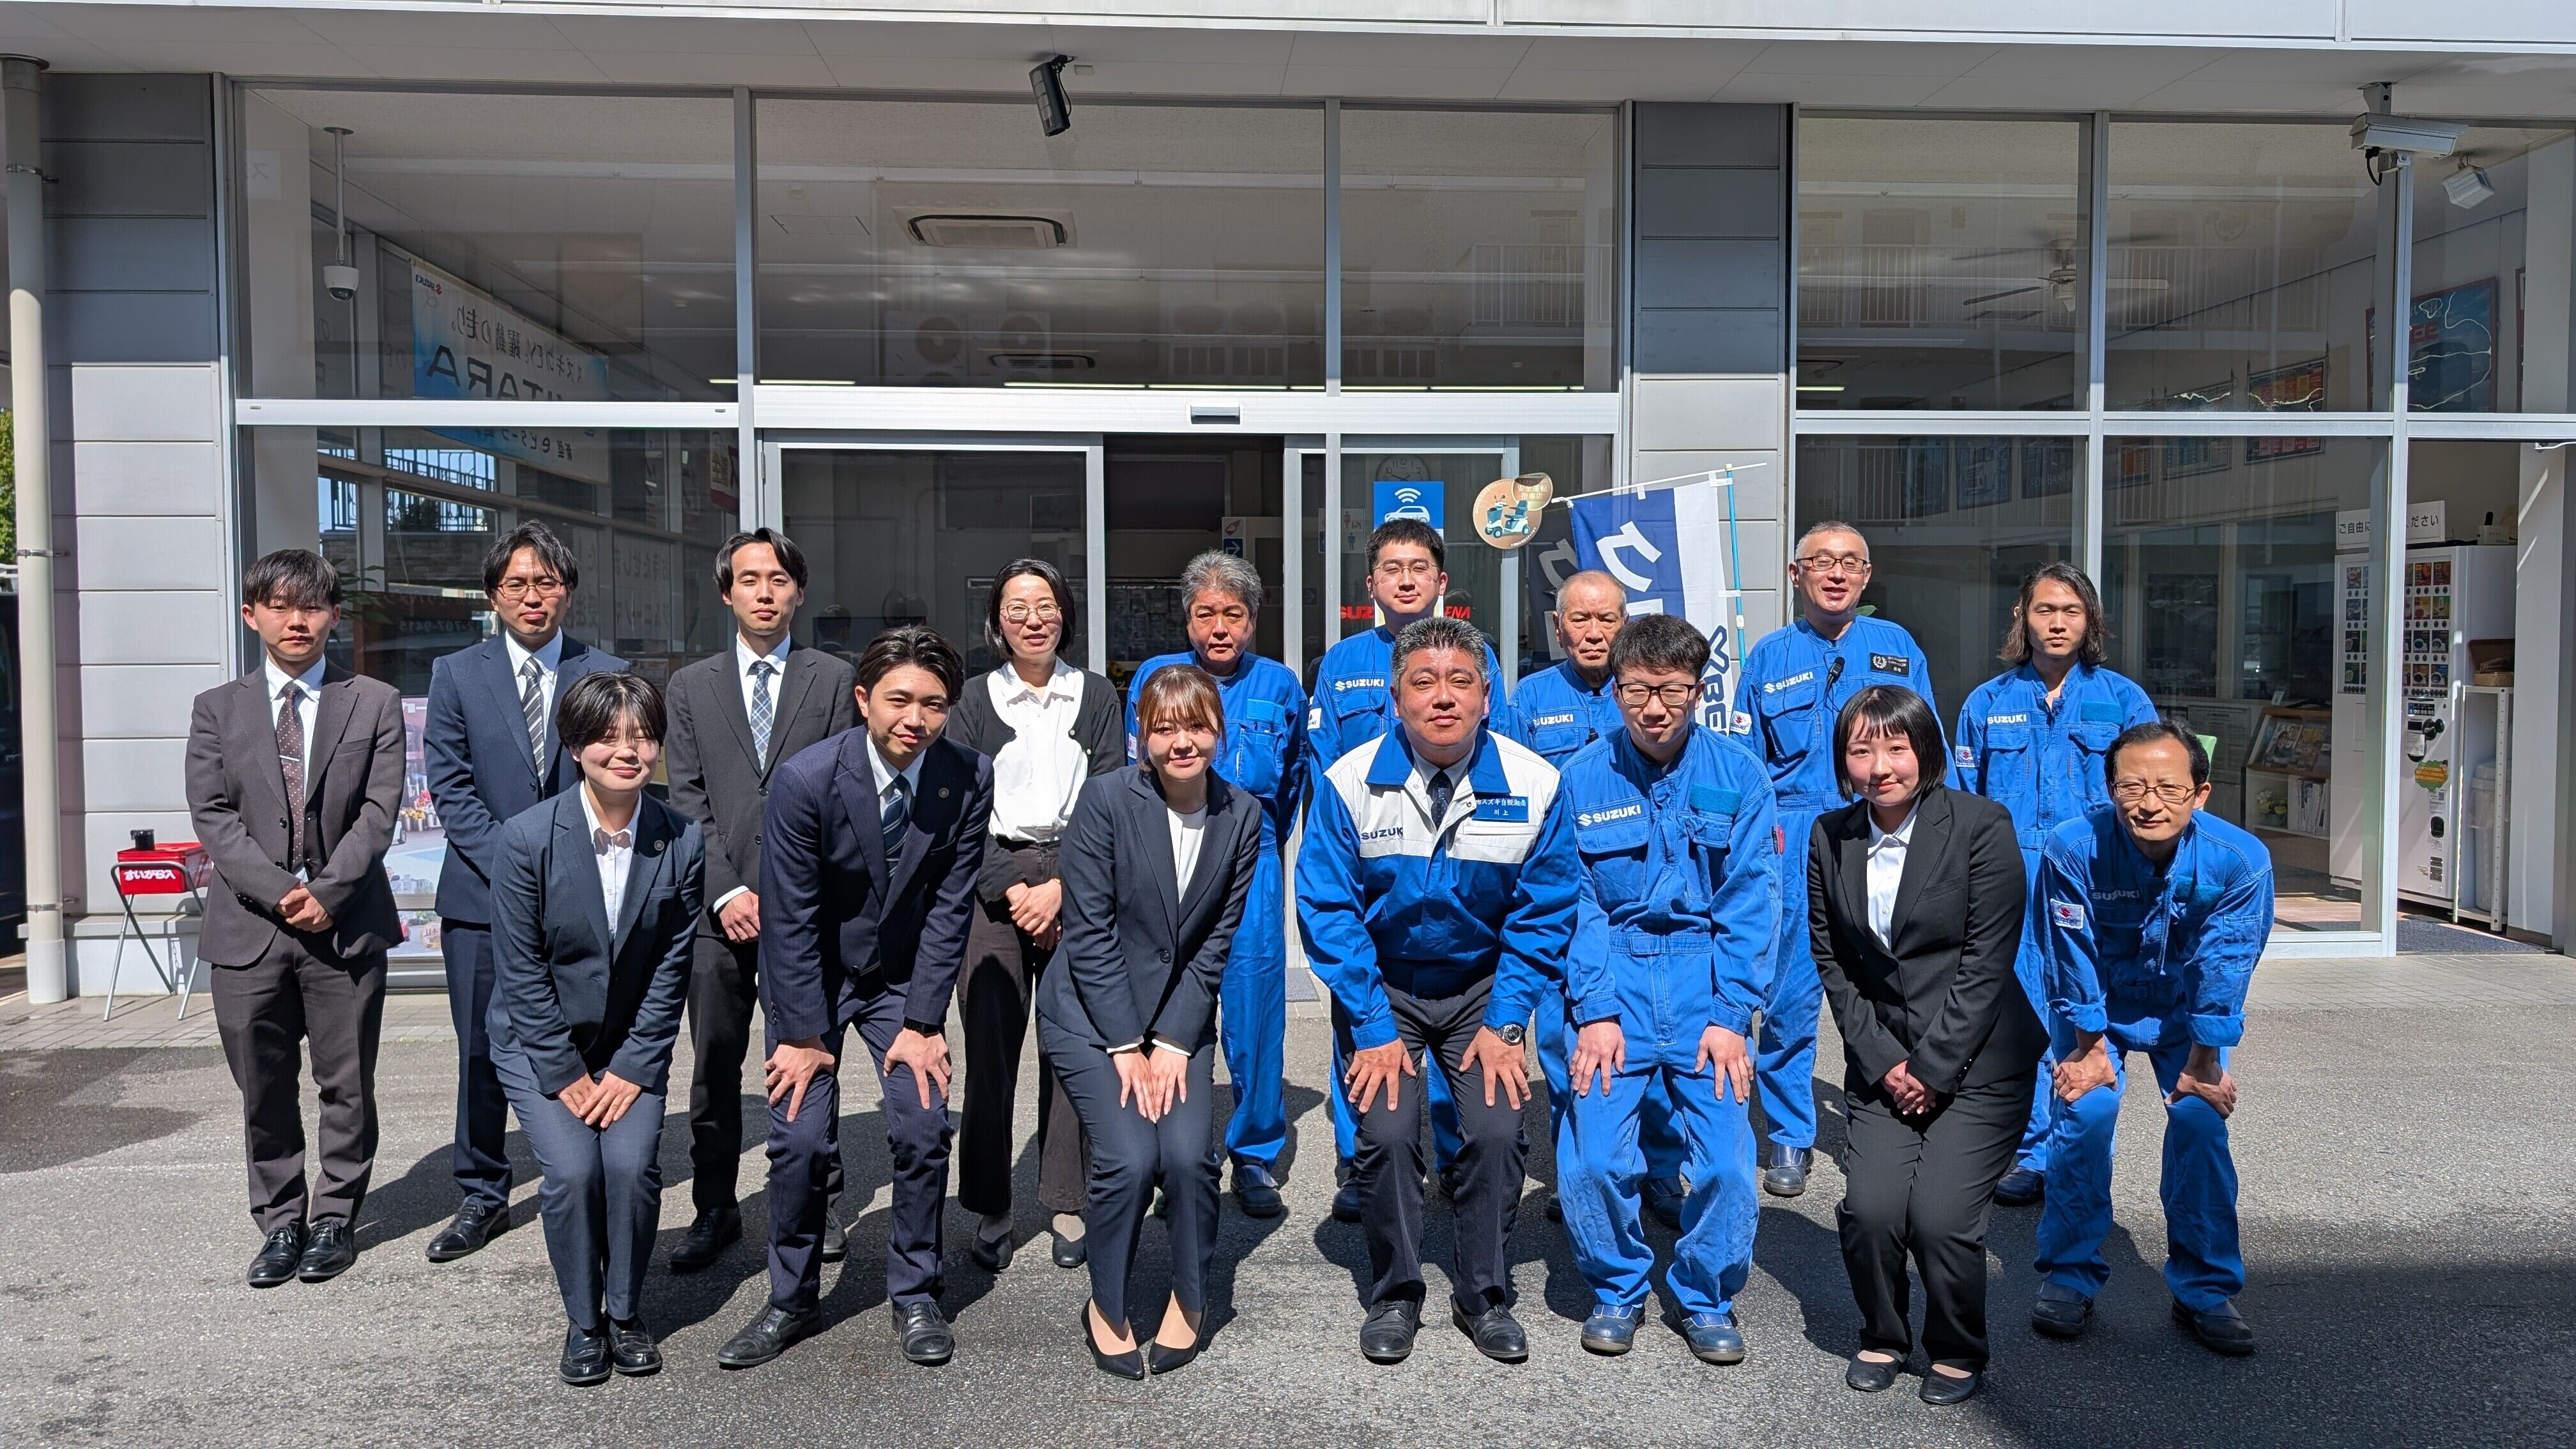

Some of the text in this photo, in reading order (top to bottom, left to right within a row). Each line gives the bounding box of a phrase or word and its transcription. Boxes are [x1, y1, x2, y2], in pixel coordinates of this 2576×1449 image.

[1346, 678, 1384, 689] SUZUKI
[1775, 671, 1814, 691] SUZUKI
[1987, 714, 2027, 724] SUZUKI
[1592, 804, 1641, 823] SUZUKI
[1360, 827, 1404, 840] SUZUK
